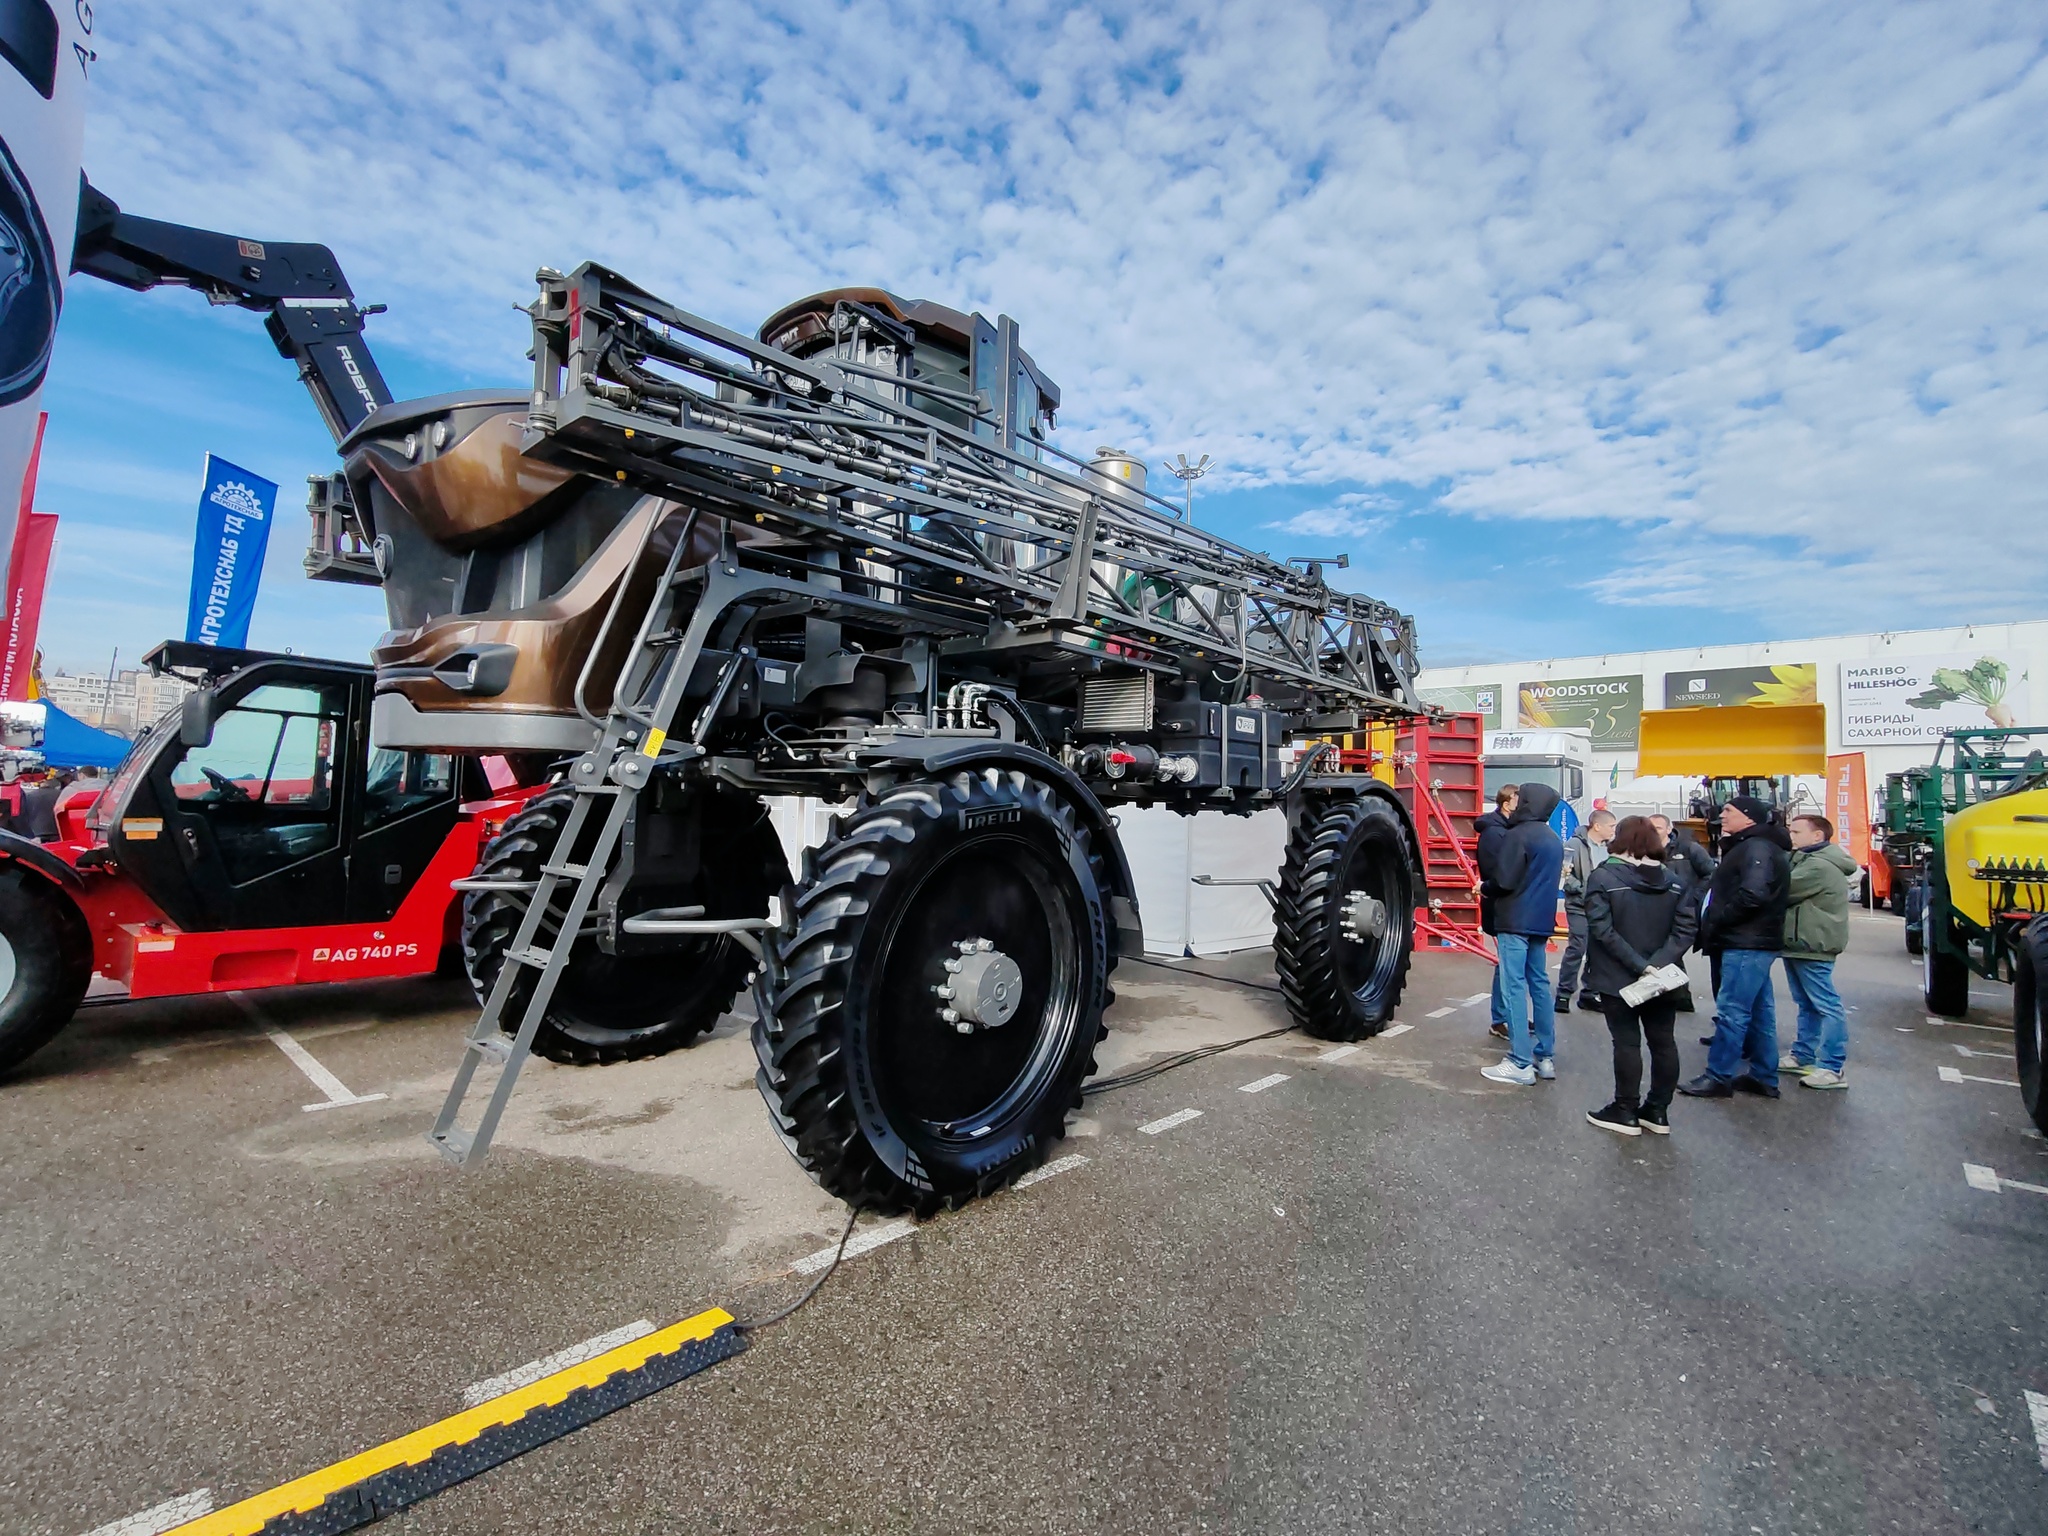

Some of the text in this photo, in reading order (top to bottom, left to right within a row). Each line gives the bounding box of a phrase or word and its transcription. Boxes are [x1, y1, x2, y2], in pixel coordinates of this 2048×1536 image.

[198, 513, 246, 646] АГРОТЕХСНАБ ТД
[1847, 666, 1906, 677] MARIBO
[1848, 677, 1918, 690] HILLESHÖG
[1530, 682, 1629, 698] WOODSTOCK
[1675, 692, 1721, 701] NEWSEED
[1848, 714, 1914, 724] ГИБРИДЫ
[1848, 725, 1922, 737] САХАРНОЙ
[1493, 737, 1523, 749] FAW
[330, 943, 418, 962] AG 740 PS
